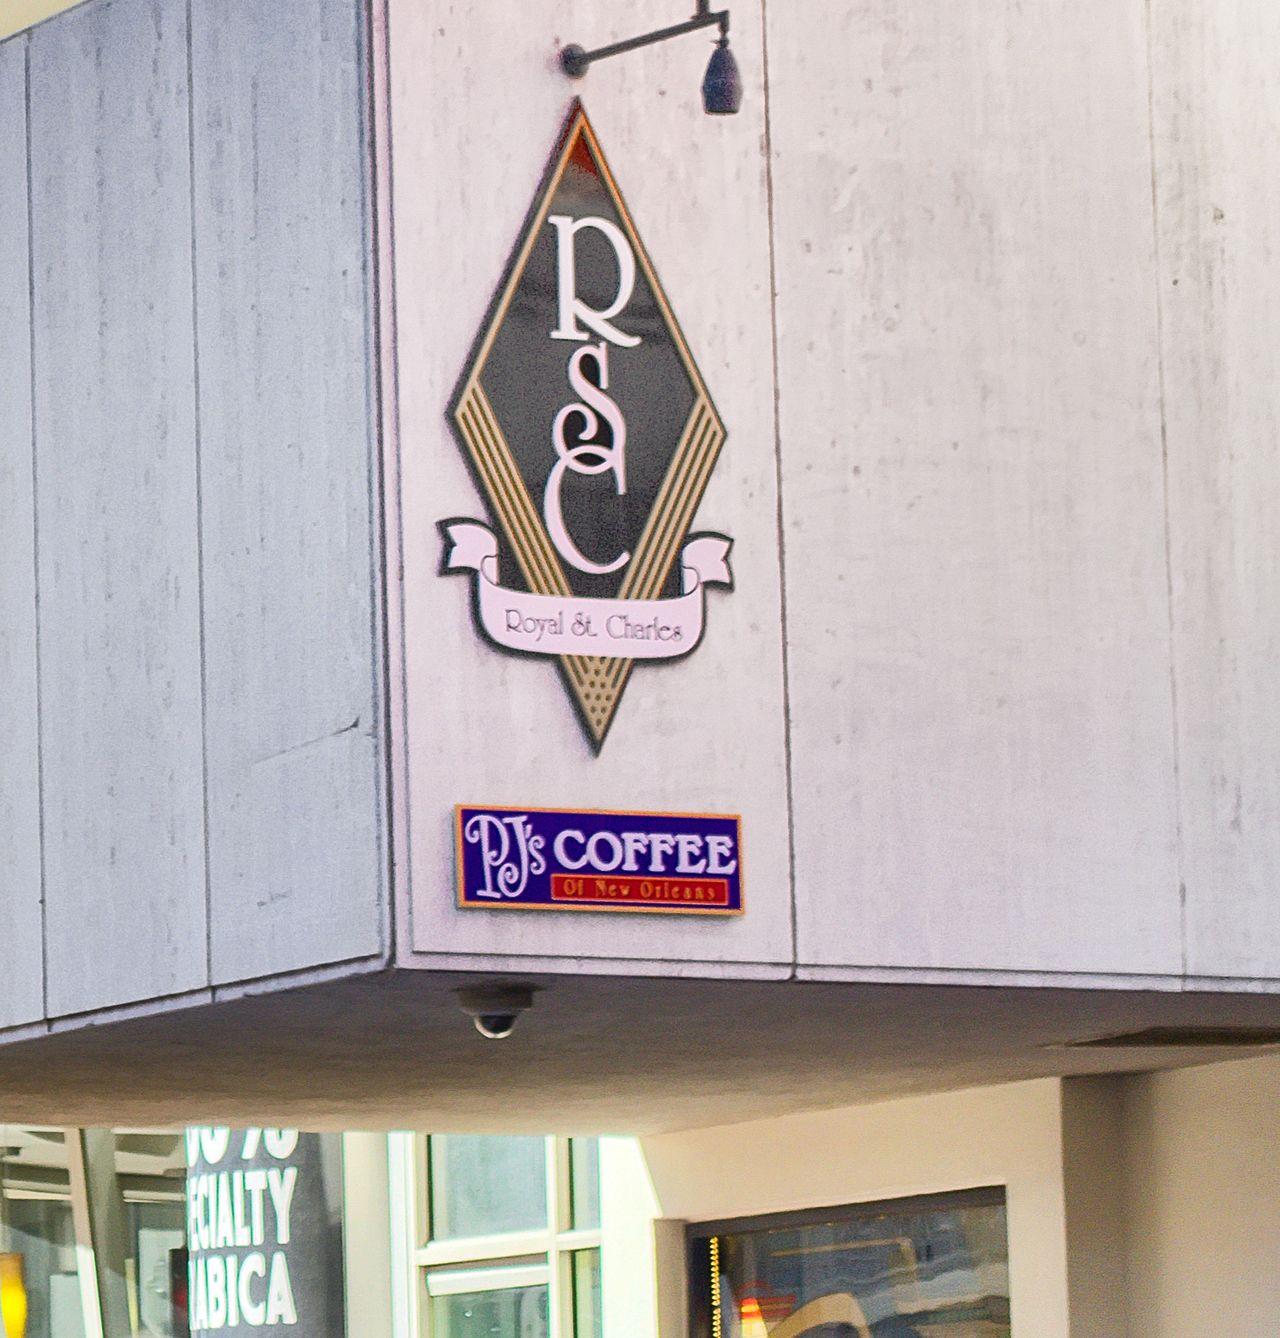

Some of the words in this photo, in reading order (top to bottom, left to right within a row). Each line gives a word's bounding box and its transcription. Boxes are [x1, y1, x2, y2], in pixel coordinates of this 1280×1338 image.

[505, 609, 563, 642] Royal
[606, 614, 683, 642] Charles
[464, 814, 546, 898] PJ's
[553, 829, 737, 875] COFFEE
[563, 878, 585, 896] Of
[595, 879, 631, 897] New
[639, 881, 716, 900] Orleans
